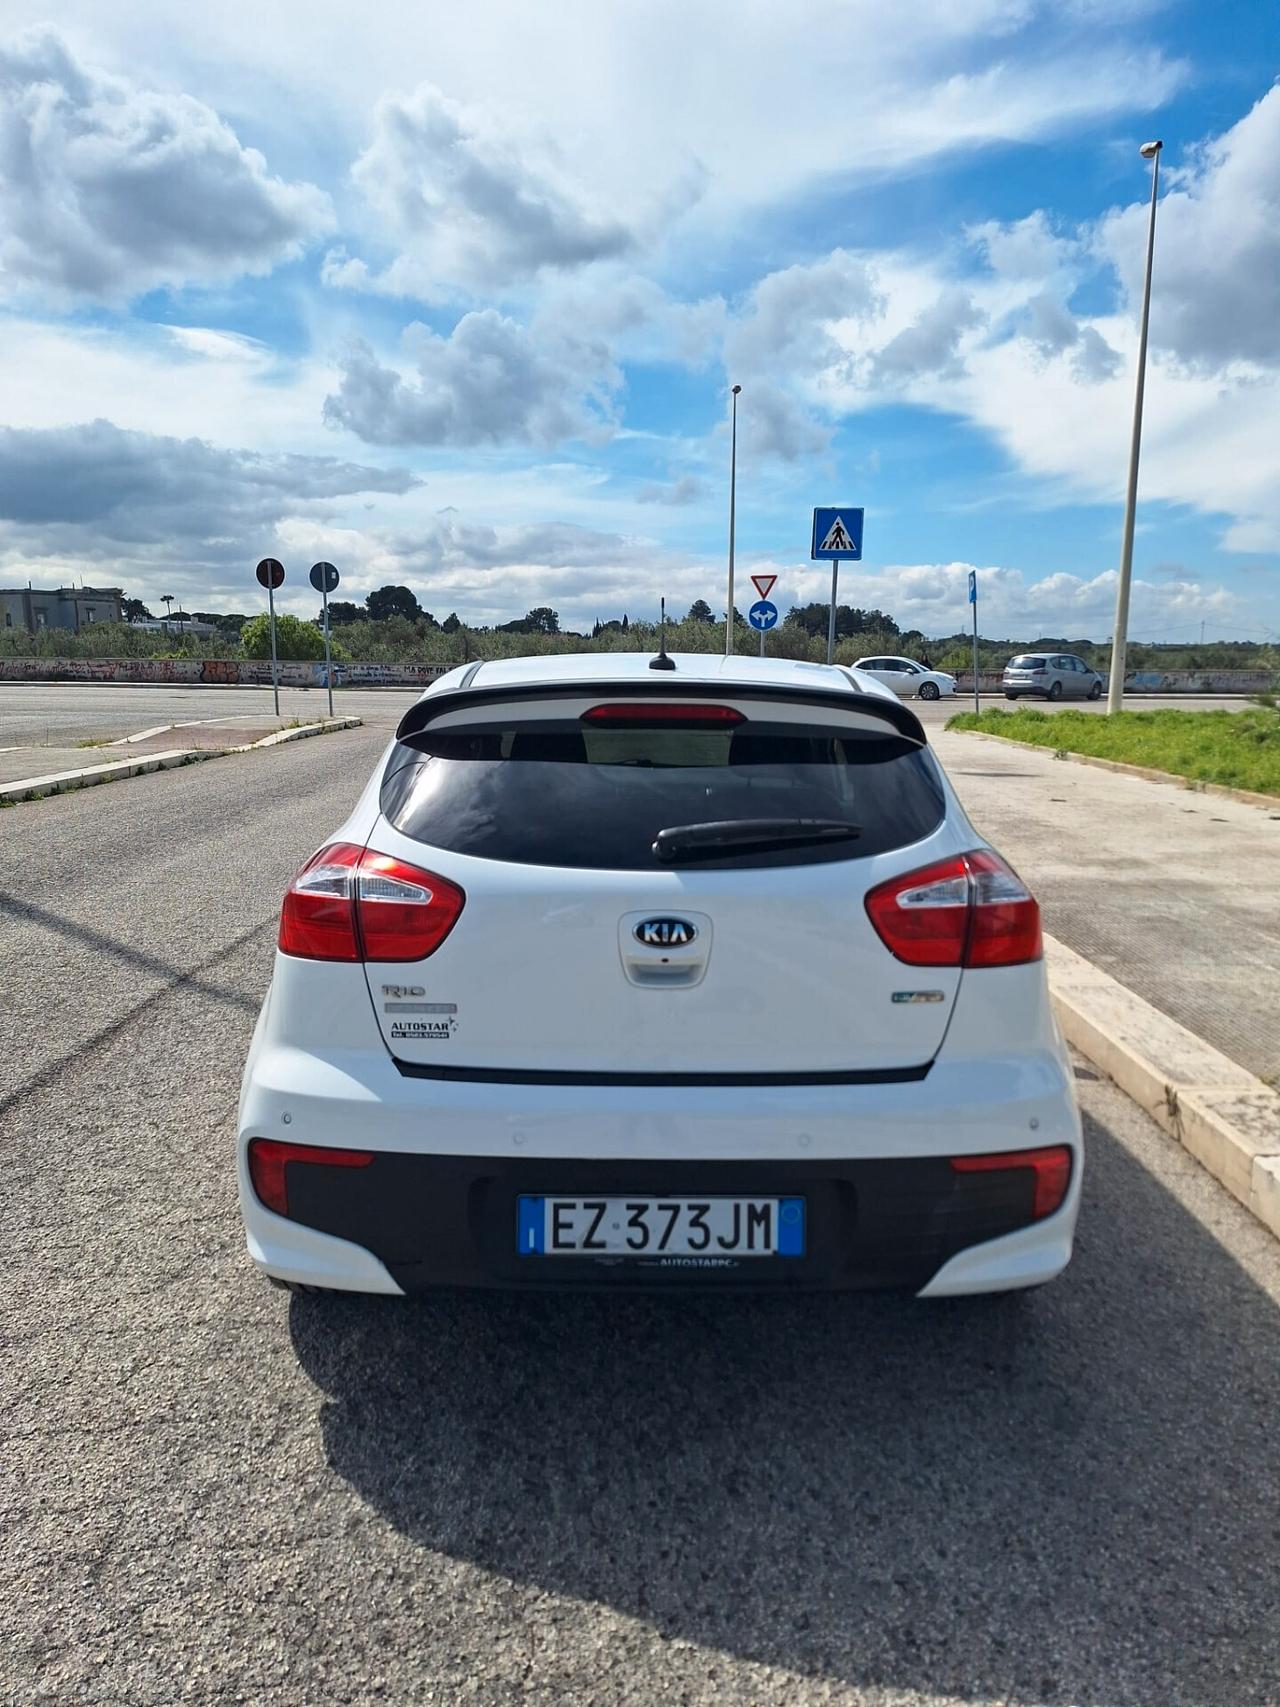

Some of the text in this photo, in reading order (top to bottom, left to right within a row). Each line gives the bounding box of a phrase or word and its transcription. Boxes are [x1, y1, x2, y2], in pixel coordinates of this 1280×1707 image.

[644, 923, 687, 942] KIA
[382, 985, 425, 998] RIO
[392, 1022, 449, 1031] AUTOSTAR
